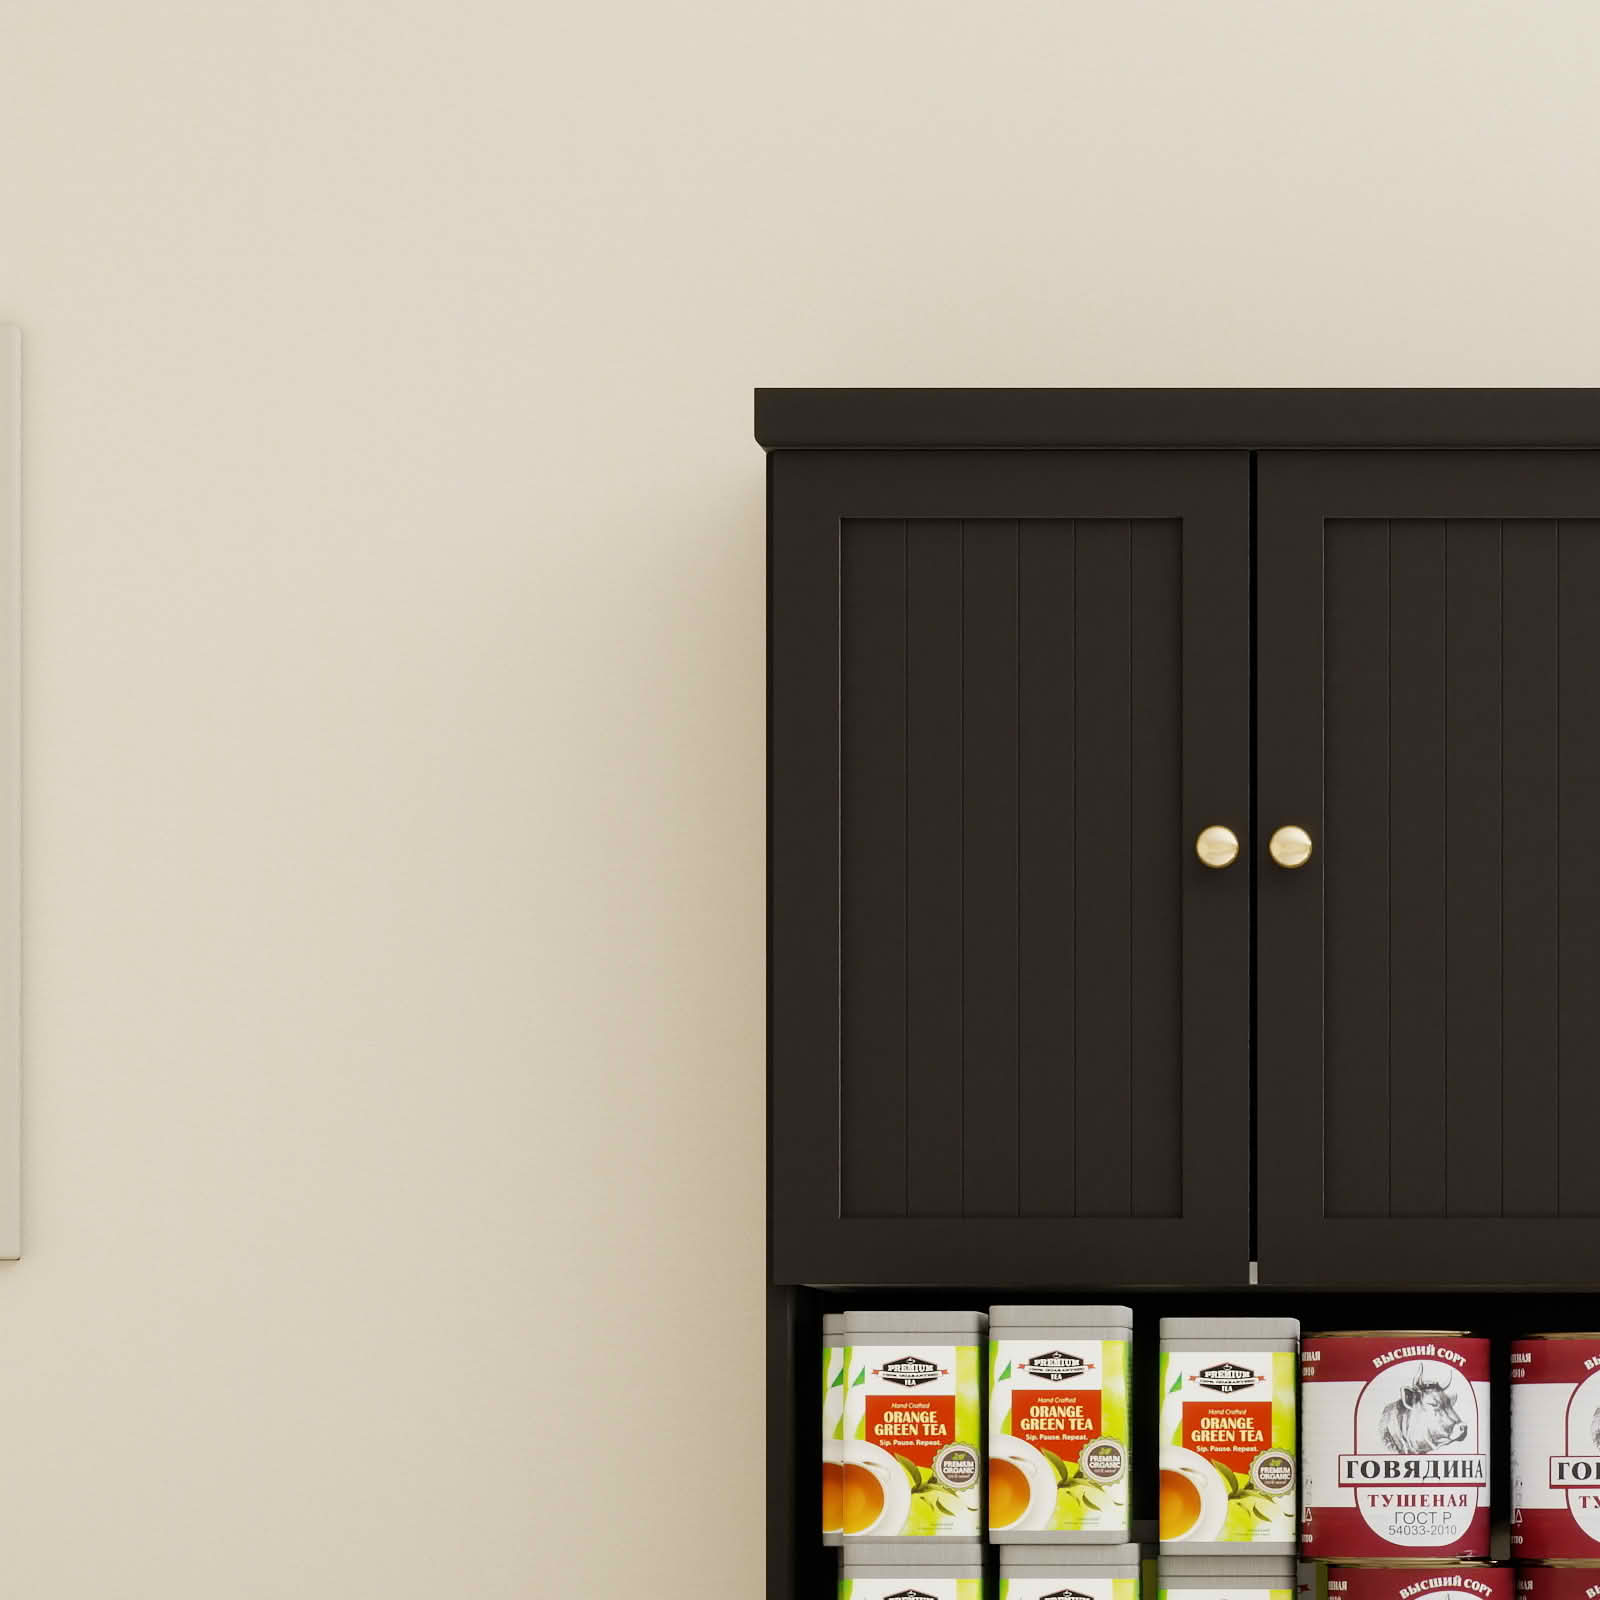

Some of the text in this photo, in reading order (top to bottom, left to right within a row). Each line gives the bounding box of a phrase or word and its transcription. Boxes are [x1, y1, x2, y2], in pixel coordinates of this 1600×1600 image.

[1034, 1358, 1080, 1367] PREMIUM
[1372, 1344, 1467, 1369] ВЫСШИЙ СОРТ
[888, 1364, 933, 1373] PREMIUM
[1204, 1370, 1250, 1379] PREMIUM
[884, 1411, 938, 1423] ORANGE
[1030, 1405, 1084, 1418] ORANGE
[1020, 1419, 1093, 1431] GREEN TEA
[1200, 1417, 1255, 1429] ORANGE
[874, 1424, 947, 1436] GREEN TEA
[1191, 1430, 1264, 1442] GREEN TEA
[1346, 1460, 1484, 1480] ГОВЯДИНА
[1368, 1494, 1467, 1507] ТУШЕНАЯ
[1395, 1511, 1452, 1524] ГОСТ Р
[1388, 1525, 1458, 1536] 54033-2010
[1399, 1575, 1462, 1600] ВЫСШИЙ
[1463, 1578, 1493, 1598] СОРТ
